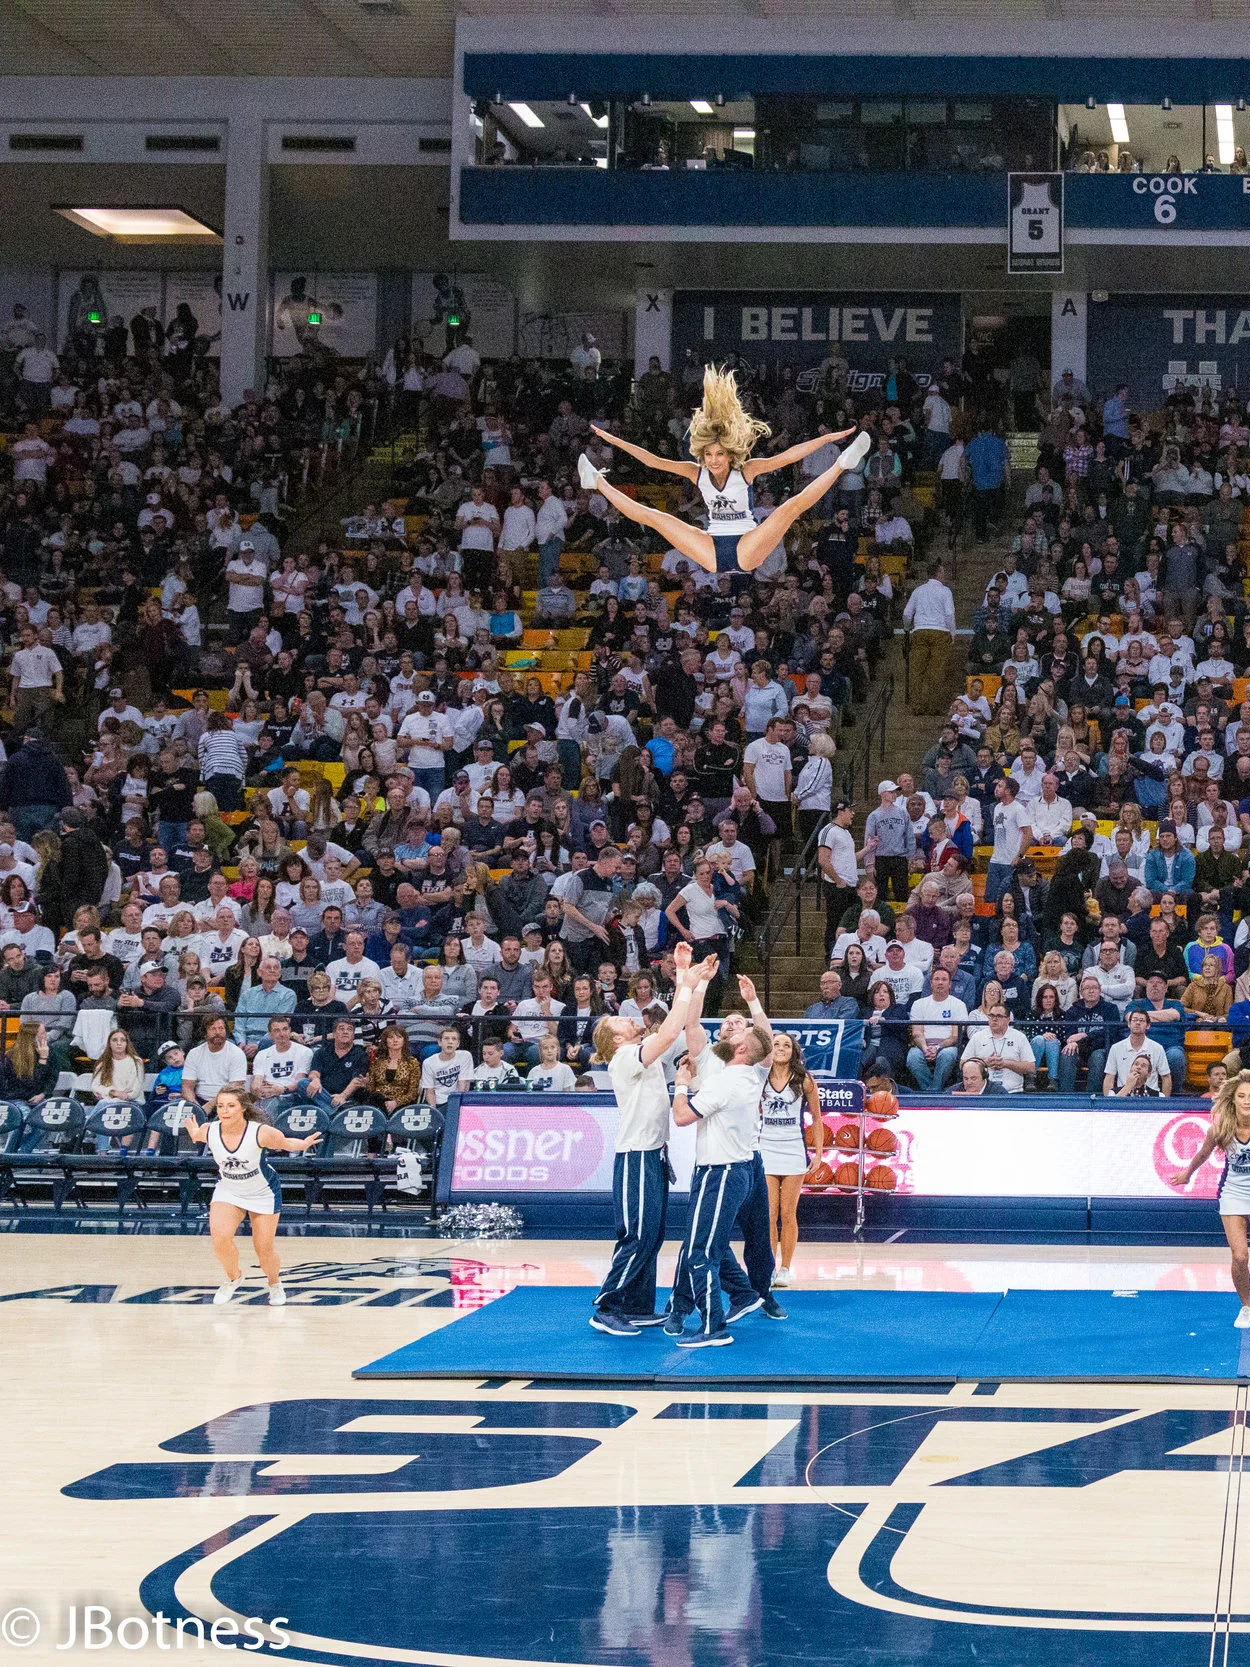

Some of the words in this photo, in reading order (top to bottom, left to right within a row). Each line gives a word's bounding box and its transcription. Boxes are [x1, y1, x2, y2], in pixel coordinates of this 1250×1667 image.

[1132, 177, 1198, 195] COOK
[1021, 208, 1050, 216] GRANT
[1153, 194, 1177, 224] 6
[1027, 219, 1044, 241] 5
[228, 292, 250, 311] W
[645, 294, 661, 312] X
[1060, 298, 1078, 317] A
[703, 307, 715, 340] I
[741, 306, 933, 342] BELIEVE
[436, 1069, 450, 1078] UTAH
[818, 1087, 854, 1100] State
[764, 1117, 778, 1126] UTAH
[778, 1116, 797, 1125] STATE
[1231, 1164, 1249, 1174] UTAH
